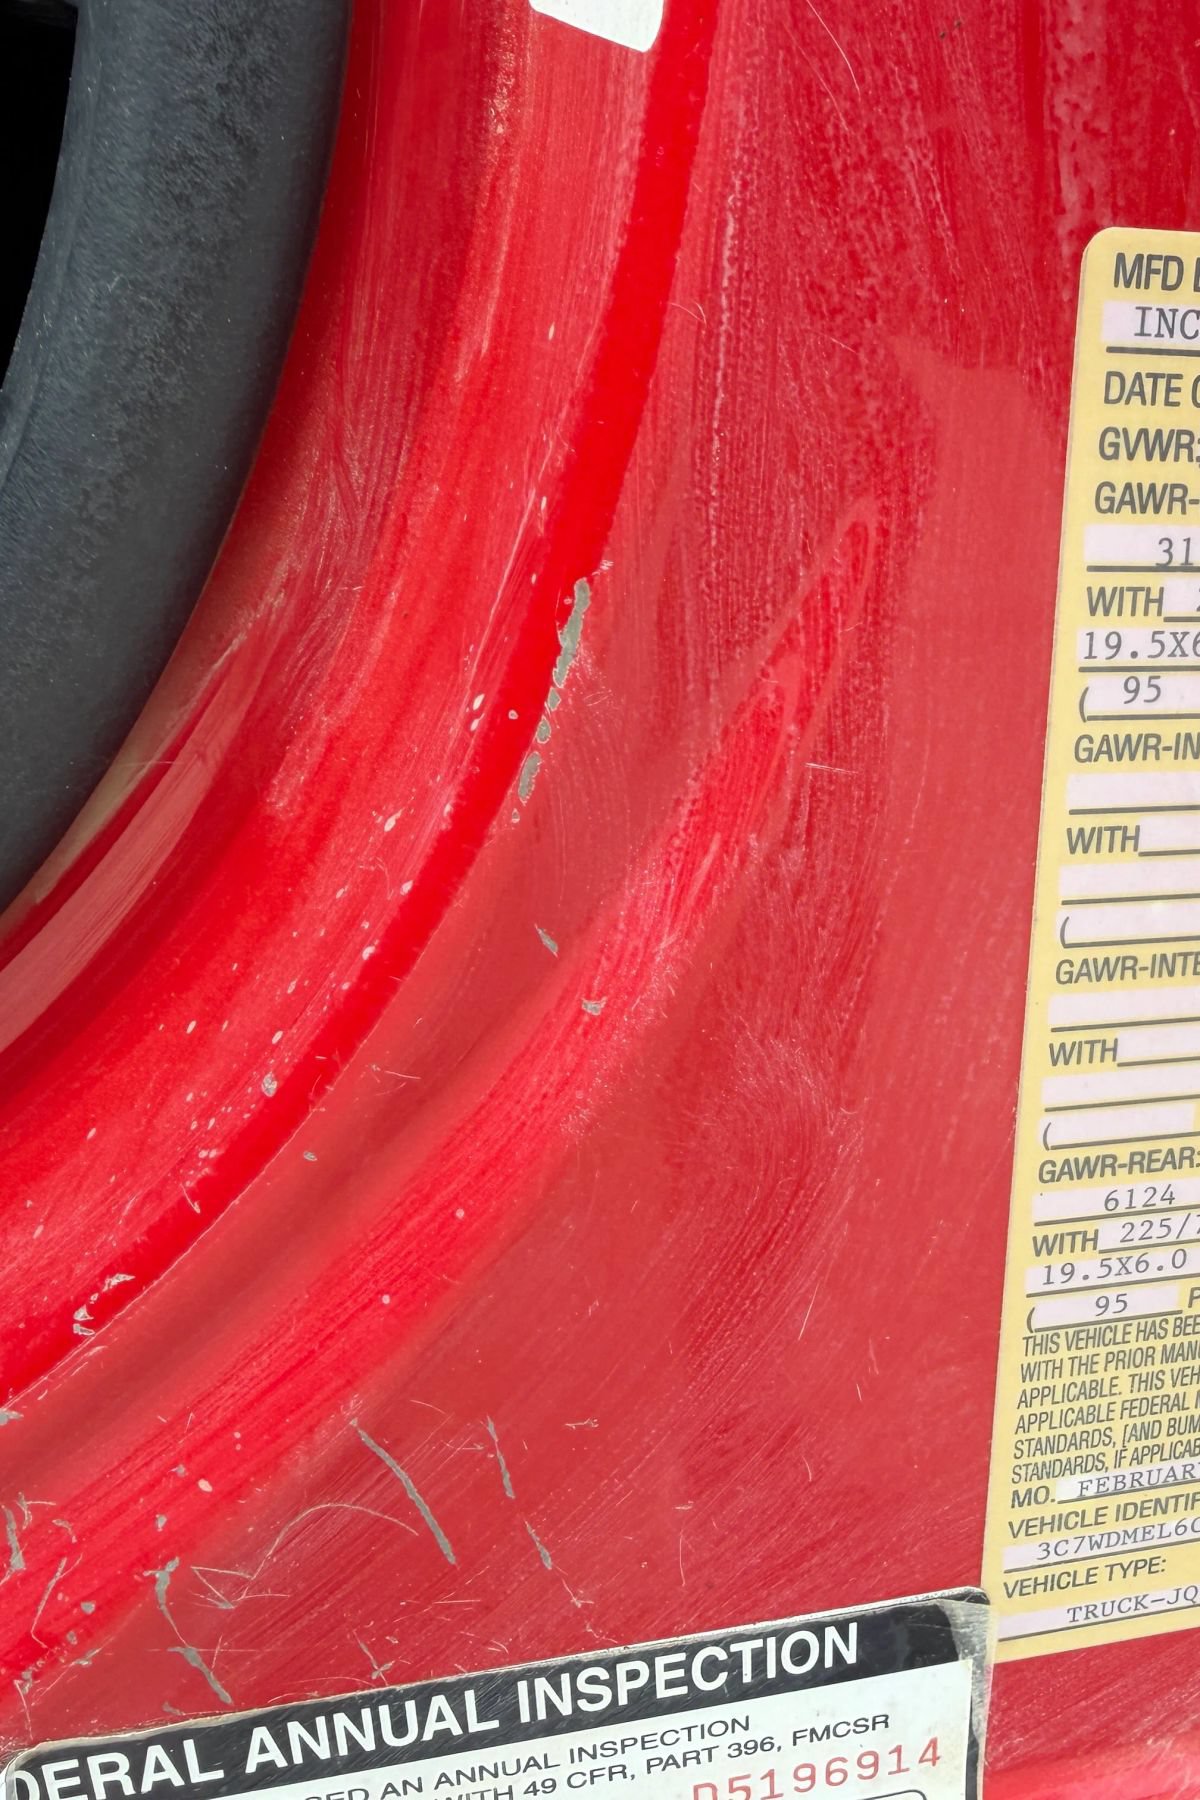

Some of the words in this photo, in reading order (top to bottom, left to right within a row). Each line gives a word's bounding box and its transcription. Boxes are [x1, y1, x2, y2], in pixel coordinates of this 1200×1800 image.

[1113, 252, 1184, 292] MFD
[1104, 372, 1182, 408] DATE
[1087, 586, 1165, 617] WITH
[1123, 676, 1161, 703] 95
[1066, 825, 1140, 855] WITH
[1048, 1038, 1118, 1066] WITH
[1103, 1183, 1176, 1212] 6124
[1032, 1229, 1098, 1257] WITH
[1041, 1249, 1188, 1286] 19.5X6.0
[1095, 1294, 1128, 1316] 95
[1022, 1331, 1060, 1357] THIS
[1064, 1322, 1132, 1351] VEHICLE
[1135, 1317, 1169, 1342] HAS
[1019, 1358, 1064, 1384] WITH
[1068, 1353, 1100, 1378] THE
[1104, 1344, 1157, 1372] PRIOR
[1017, 1378, 1123, 1409] APPLICABLE.
[1129, 1372, 1166, 1393] THIS
[1014, 1402, 1116, 1435] APPLICABLE
[1120, 1389, 1190, 1420] FEDERAL
[1013, 1427, 1117, 1460] STANDARDS,
[1121, 1419, 1161, 1445] [AND
[1011, 1453, 1109, 1484] STANDARDS,
[1113, 1446, 1129, 1469] IF
[1010, 1486, 1056, 1510] MO.
[1008, 1506, 1108, 1539] VEHICLE
[1003, 1567, 1097, 1600] VEHICLE
[1104, 1556, 1167, 1583] TYPE:
[245, 1690, 500, 1774] ANNUAL
[517, 1623, 859, 1724] INSPECTION
[380, 1777, 423, 1799] AN
[434, 1753, 560, 1790] ANNUAL
[569, 1715, 751, 1764] INSPECTION
[524, 1778, 557, 1796] 49
[567, 1764, 636, 1789] CFR,
[646, 1746, 719, 1774] PART
[727, 1736, 782, 1758] 396,
[792, 1714, 890, 1747] FMCSR
